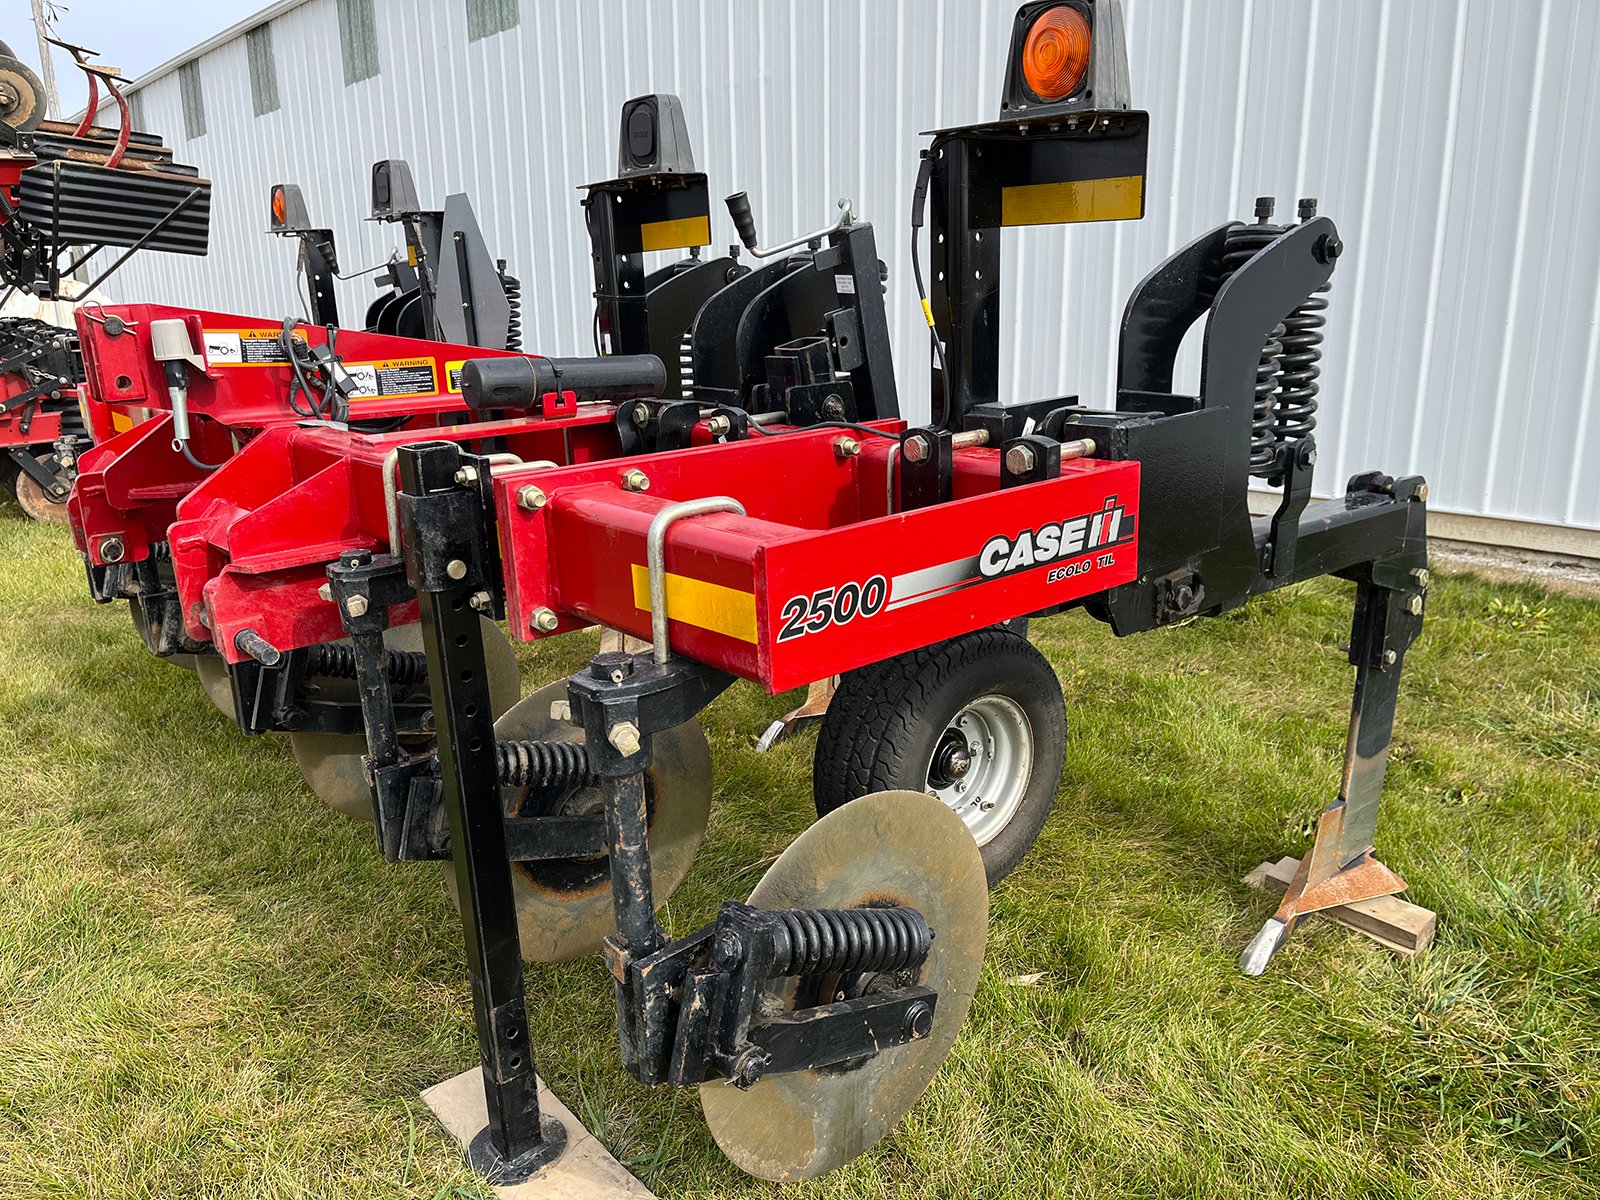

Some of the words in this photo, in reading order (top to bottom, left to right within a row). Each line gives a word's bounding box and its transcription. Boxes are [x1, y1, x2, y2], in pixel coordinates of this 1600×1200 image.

[392, 359, 429, 367] WARNING
[1047, 559, 1090, 583] ECOLO
[1097, 553, 1115, 568] TIL
[776, 574, 888, 644] 2500
